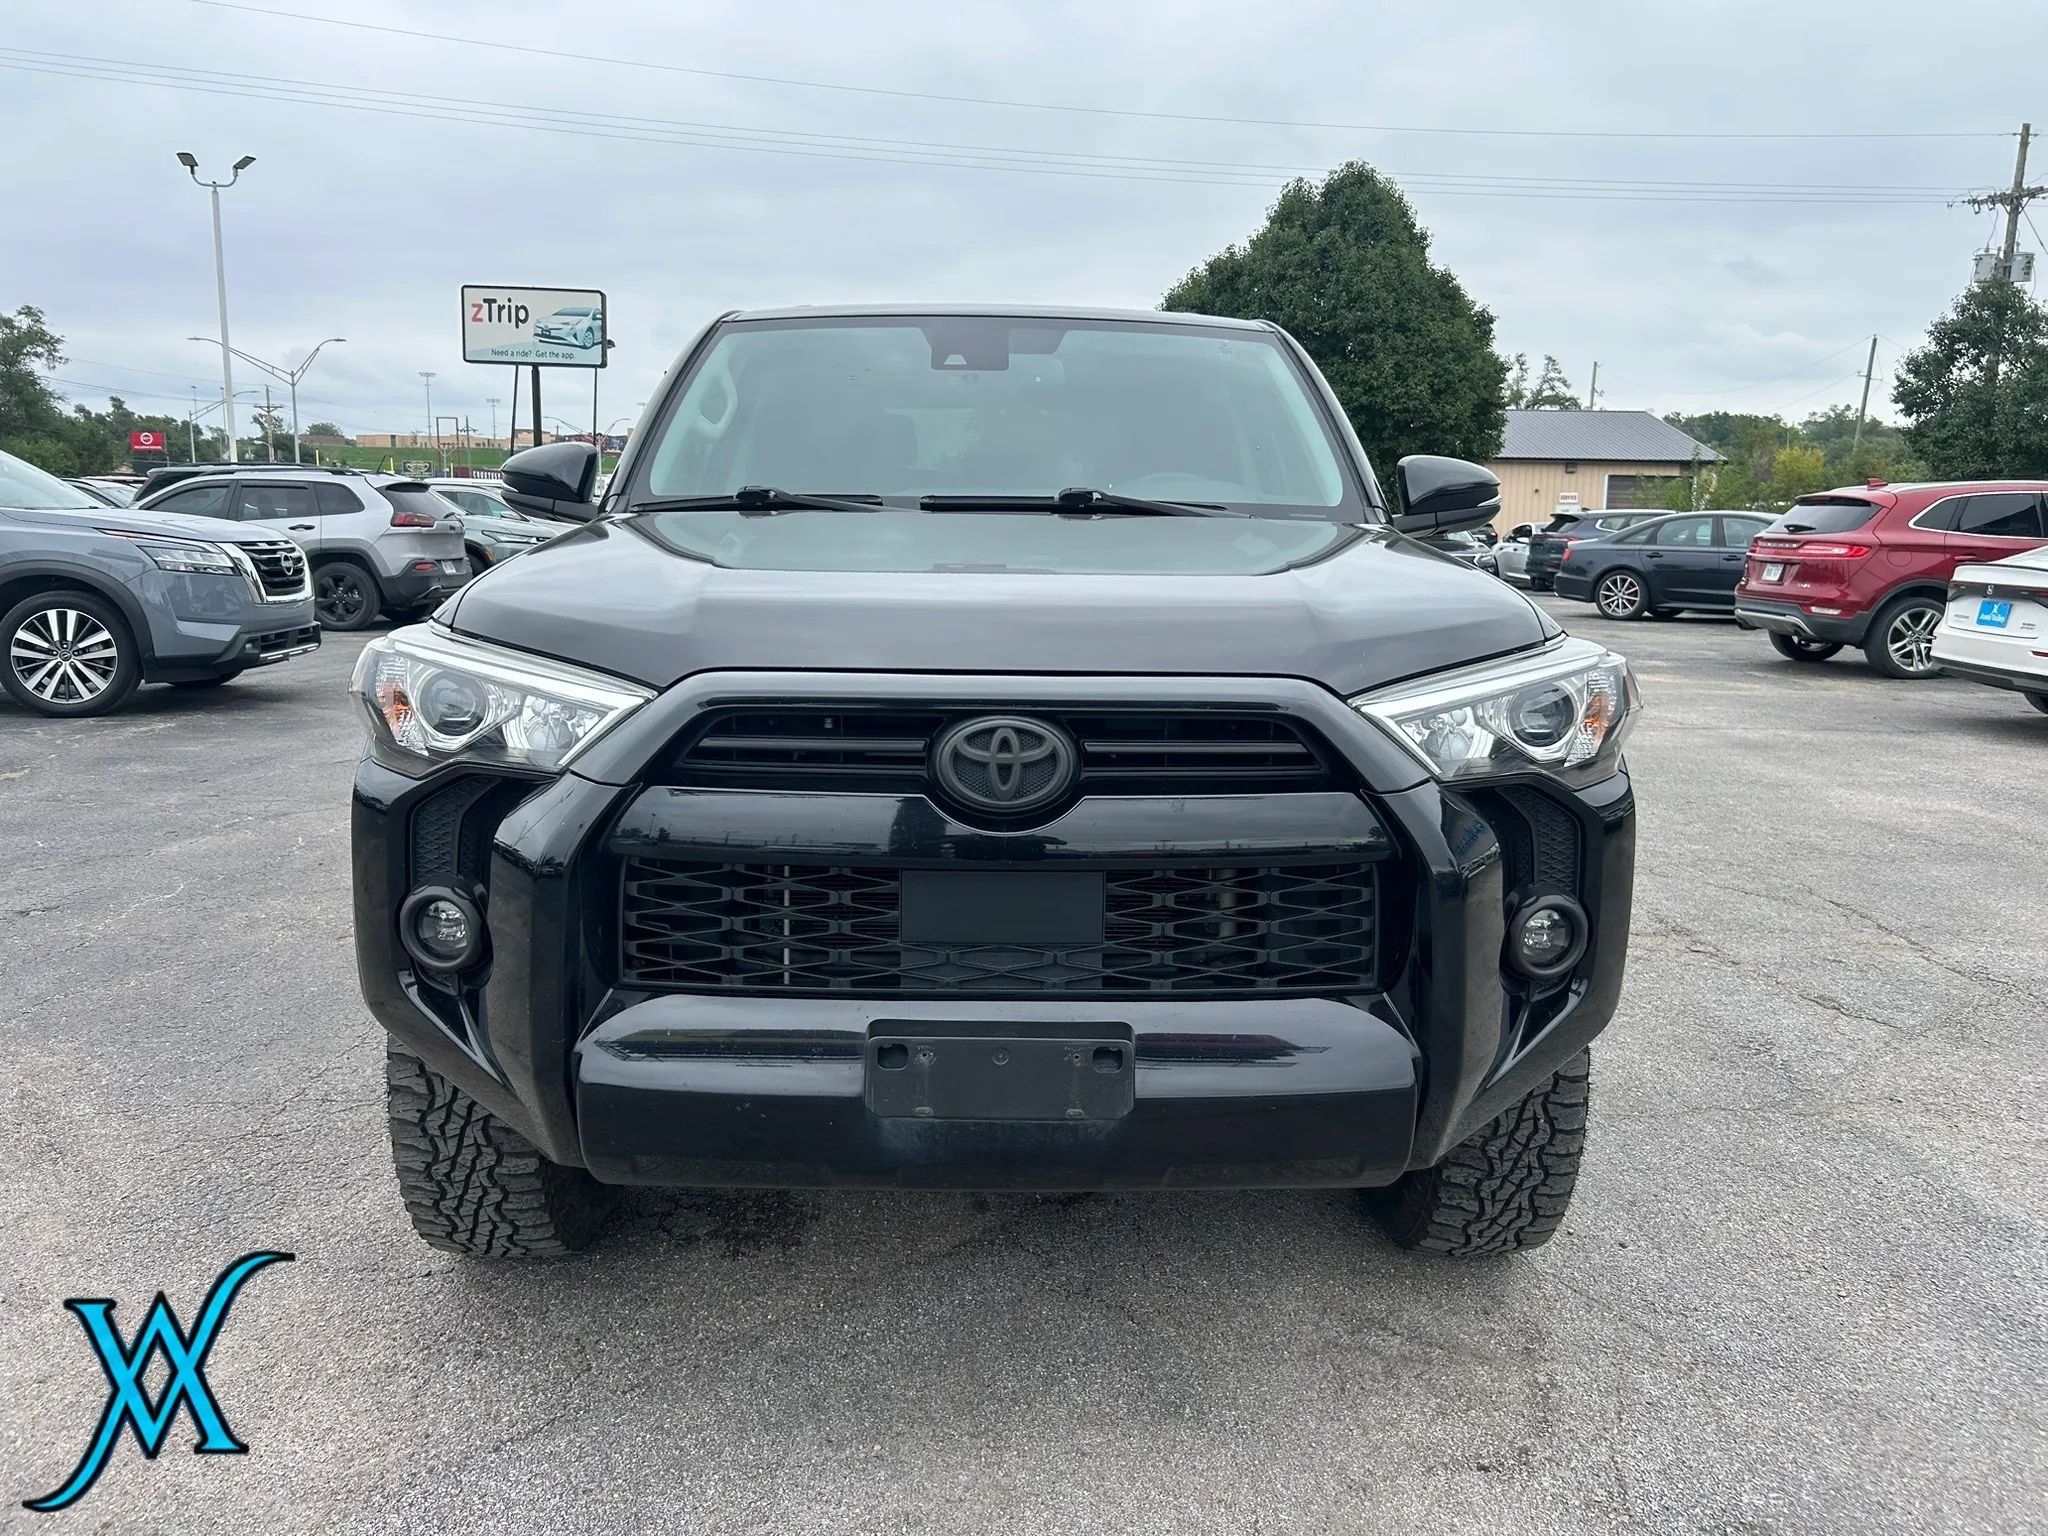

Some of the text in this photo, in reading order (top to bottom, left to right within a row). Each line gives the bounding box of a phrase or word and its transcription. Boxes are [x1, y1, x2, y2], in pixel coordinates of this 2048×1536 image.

[471, 297, 530, 329] zTrip
[491, 349, 509, 357] Need
[516, 350, 533, 358] ride?
[535, 350, 548, 358] Get
